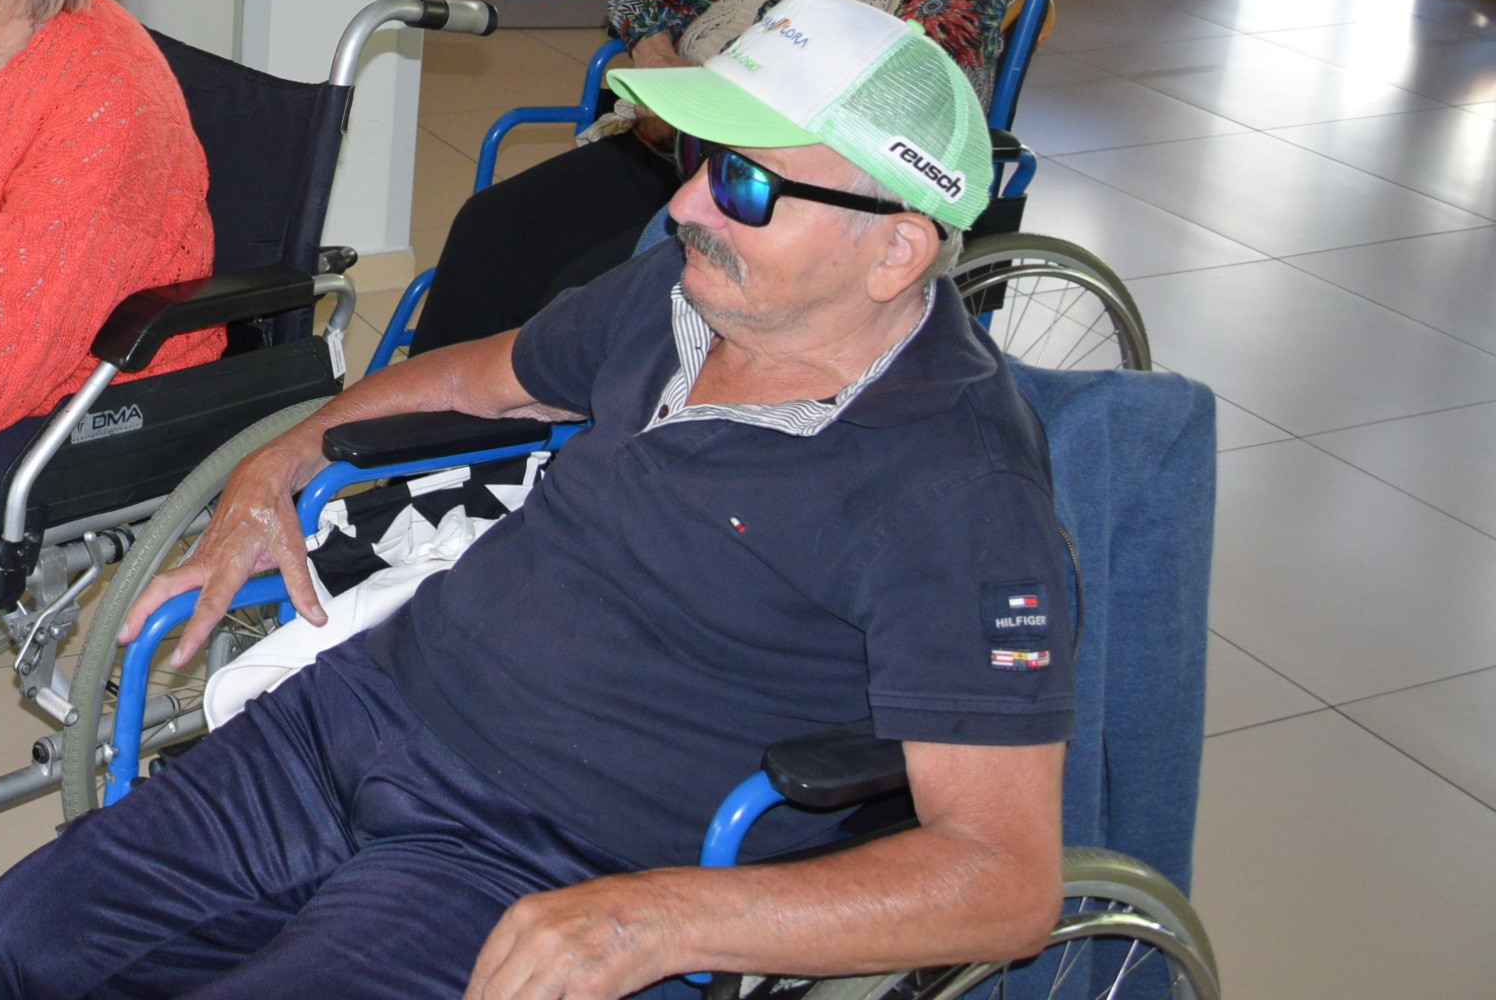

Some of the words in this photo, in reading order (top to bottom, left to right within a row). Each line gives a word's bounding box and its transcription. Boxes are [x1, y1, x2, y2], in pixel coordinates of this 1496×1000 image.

[888, 140, 964, 199] reusch
[92, 406, 142, 430] DMA
[995, 615, 1047, 629] HILFIGER
